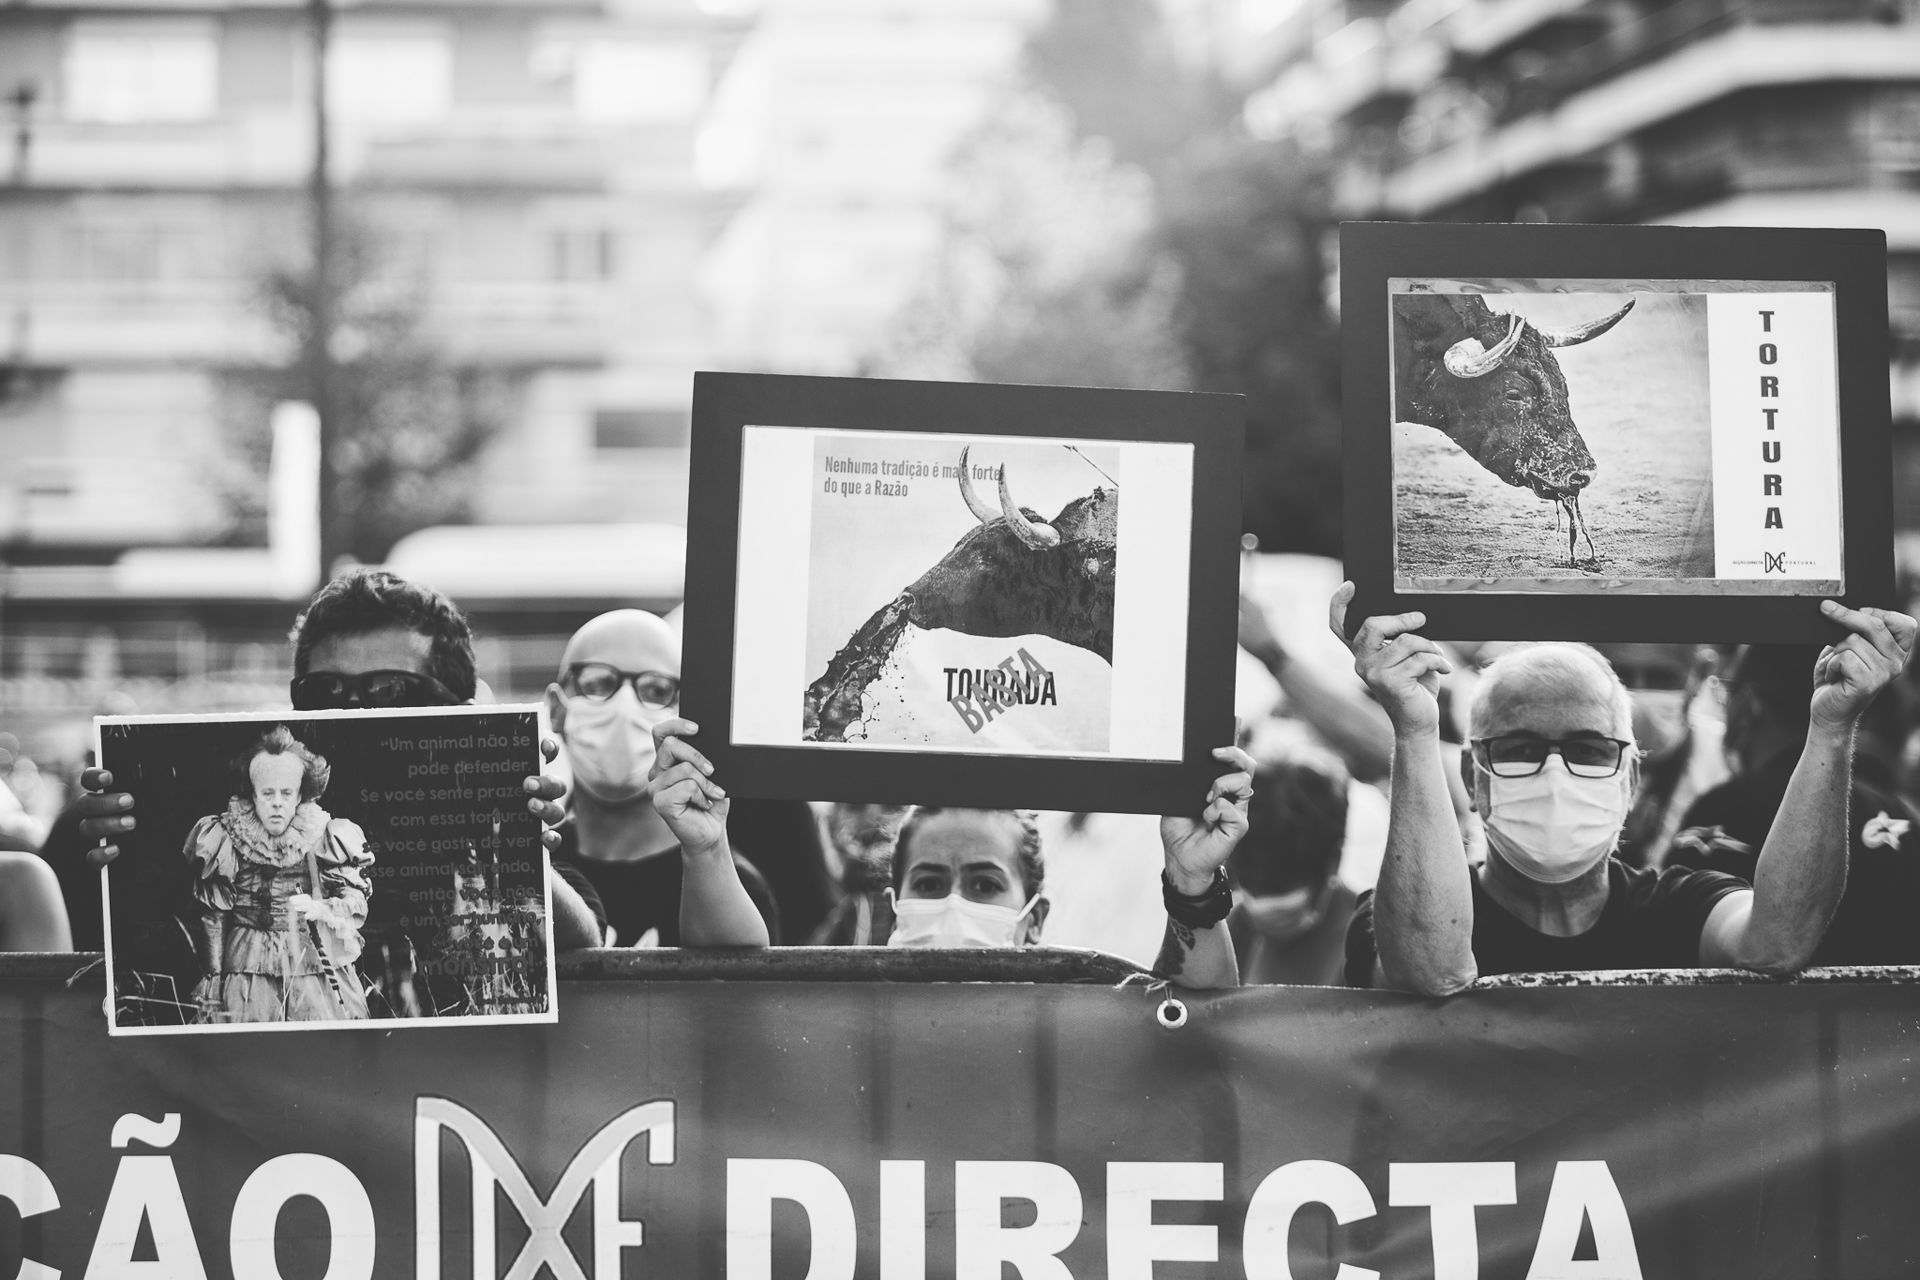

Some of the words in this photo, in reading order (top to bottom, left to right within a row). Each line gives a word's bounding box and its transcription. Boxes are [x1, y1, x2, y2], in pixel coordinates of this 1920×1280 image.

[1758, 310, 1784, 529] TORTURA
[825, 456, 878, 475] Nenhuma
[881, 460, 929, 480] tradição
[932, 462, 939, 478] é
[942, 466, 963, 480] ma
[972, 464, 1001, 481] forte
[824, 477, 837, 493] do
[841, 481, 862, 498] que
[865, 482, 872, 495] a
[875, 479, 908, 497] Razão
[943, 668, 1057, 706] TOURADA
[951, 647, 1053, 735] BASTA
[418, 735, 473, 750] animal
[477, 734, 508, 748] não
[512, 735, 531, 747] se
[408, 761, 449, 778] pode
[454, 759, 531, 775] defender.
[360, 789, 380, 802] Se
[430, 786, 473, 800] sente
[390, 815, 425, 826] com
[430, 814, 466, 826] essa
[431, 837, 476, 853] gosta
[480, 835, 501, 849] de
[506, 836, 533, 848] ver
[400, 861, 455, 877] animal
[409, 887, 455, 901] então
[414, 914, 439, 927] um
[726, 1155, 1645, 1280] DIRECTA
